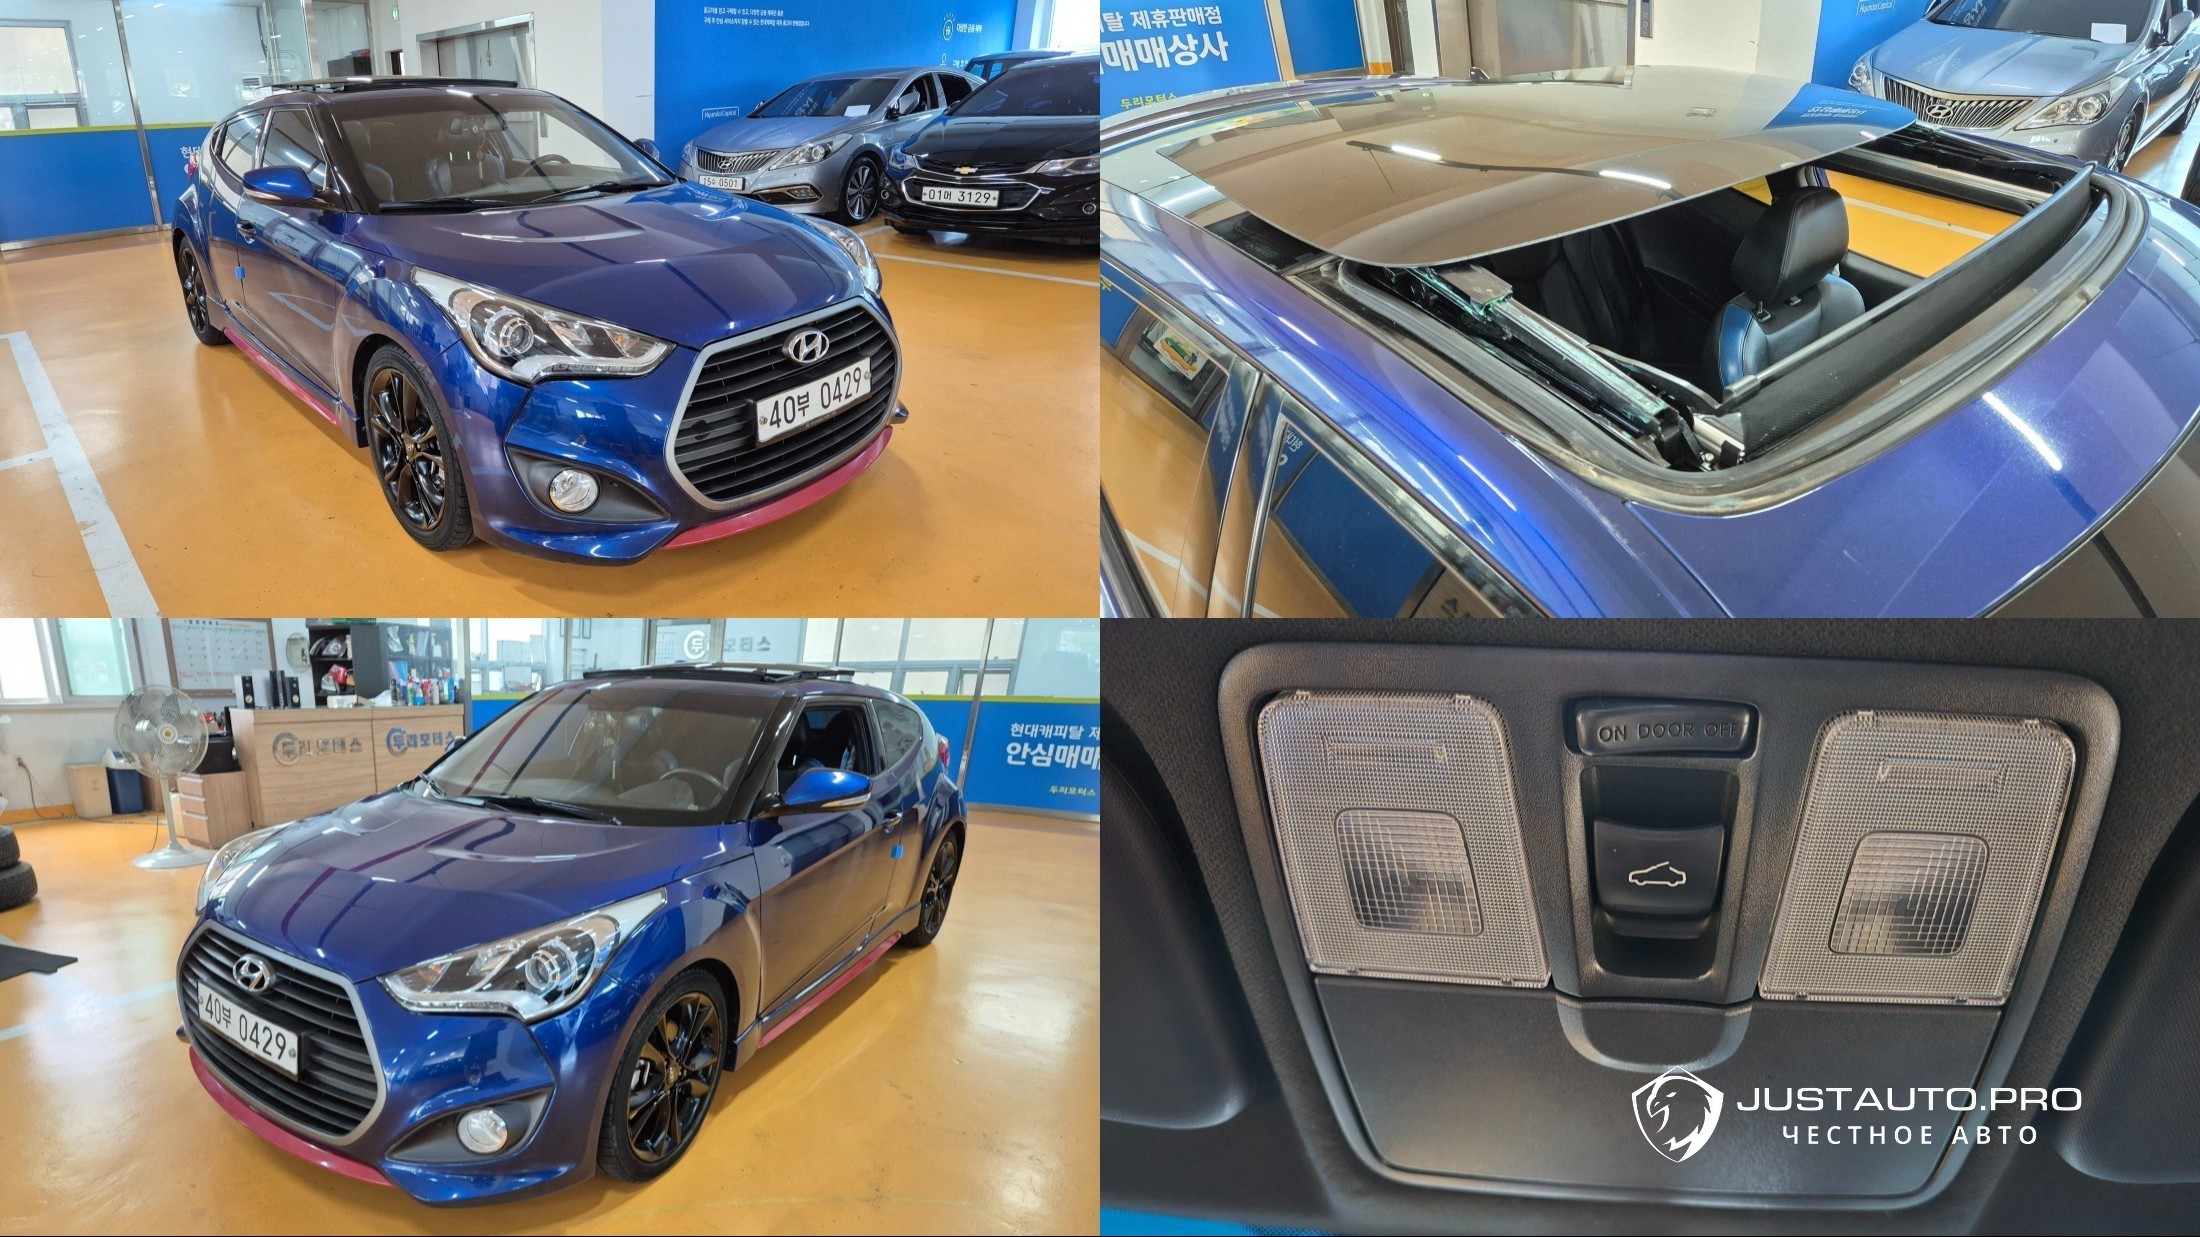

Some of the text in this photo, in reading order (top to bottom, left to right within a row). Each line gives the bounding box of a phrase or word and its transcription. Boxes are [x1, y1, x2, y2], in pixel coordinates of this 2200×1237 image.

[1130, 6, 1223, 30] 제휴판매점
[1100, 31, 1229, 75] 매매상사
[719, 178, 738, 188] 0501
[928, 189, 991, 204] 01머 3129
[769, 391, 810, 428] 40부
[820, 367, 862, 409] 0429
[1010, 722, 1085, 740] 현대캐피탈
[1598, 722, 1738, 743] ON DOOR OFF
[205, 993, 287, 1060] 40부 0429
